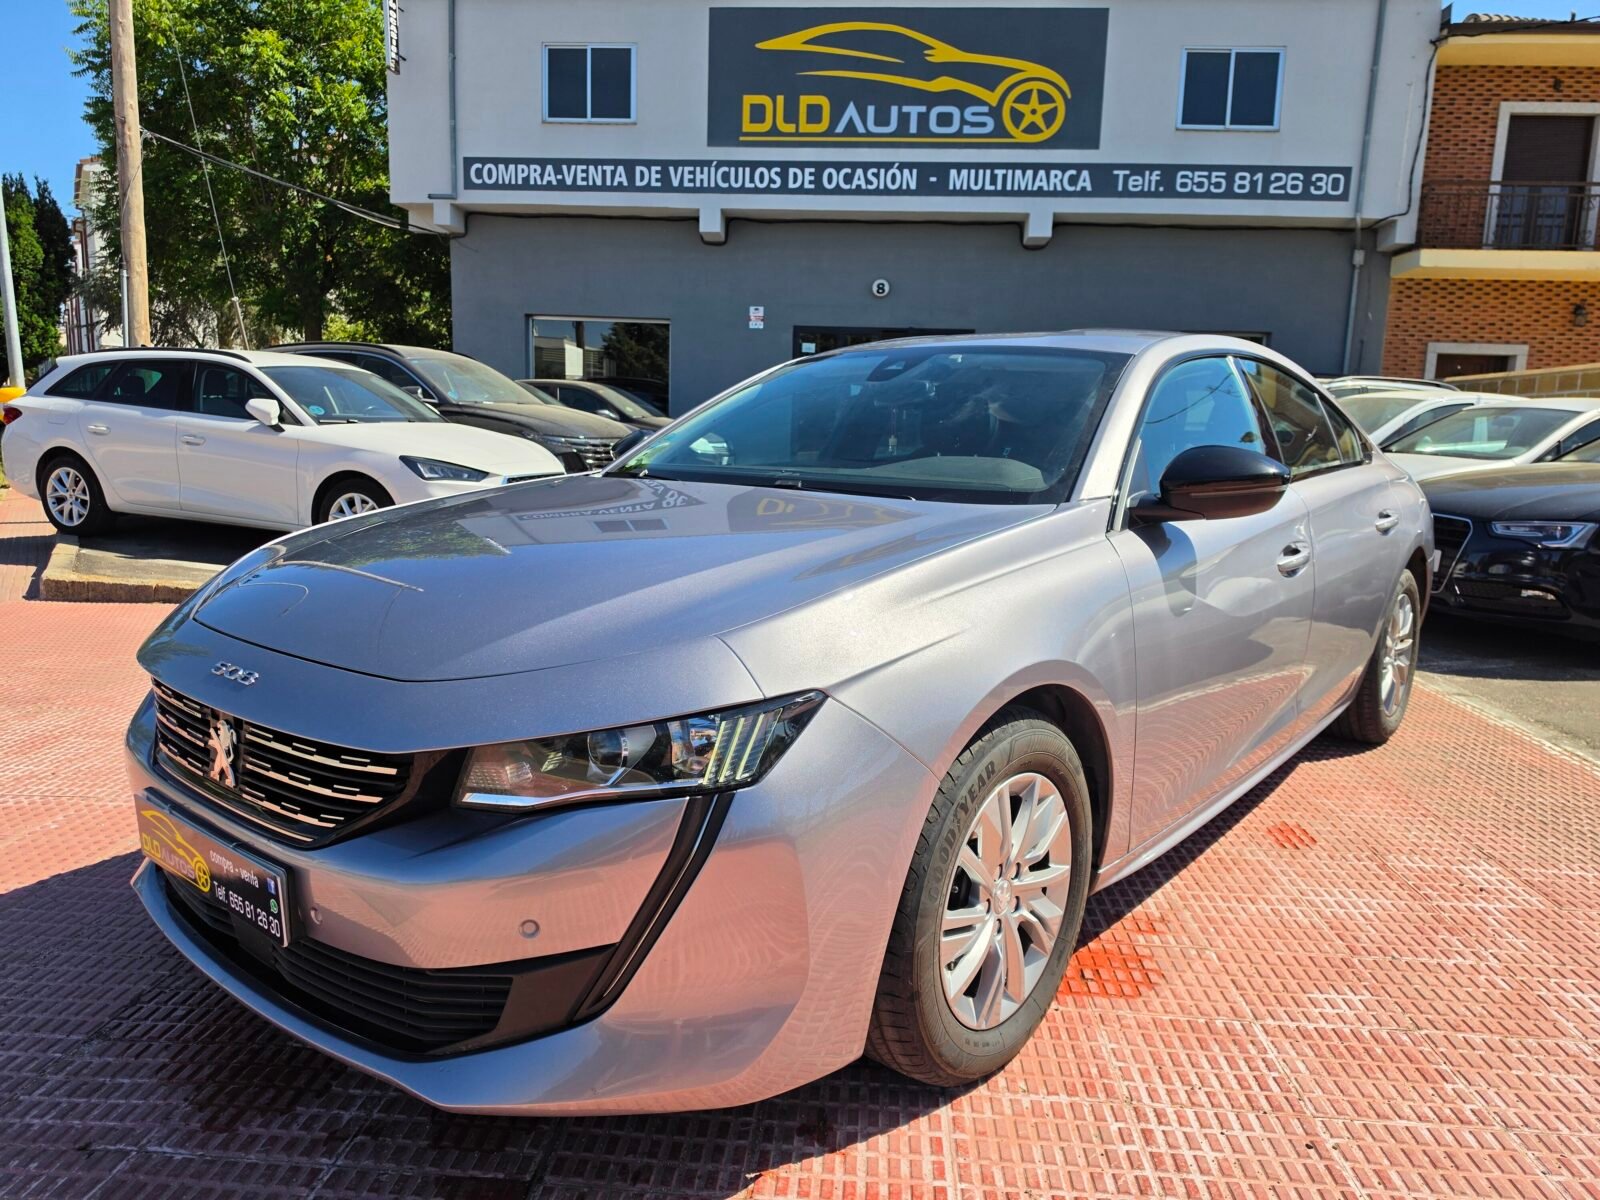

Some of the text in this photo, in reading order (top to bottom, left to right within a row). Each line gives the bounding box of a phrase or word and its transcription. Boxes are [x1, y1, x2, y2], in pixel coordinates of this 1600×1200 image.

[742, 95, 995, 134] DLD AUTOS
[470, 163, 628, 186] COMPRA-VENTA
[635, 165, 662, 187] DE
[669, 161, 781, 189] VEHÍCULOS
[788, 167, 815, 189] DE
[822, 163, 917, 190] OCASIÓN
[948, 168, 1092, 192] MULTIMARCA
[1113, 170, 1164, 192] Telf.
[1175, 171, 1226, 193] 655
[1233, 172, 1264, 194] 81
[1269, 172, 1304, 195] 26
[1310, 173, 1345, 195] 30
[876, 283, 886, 294] 8
[211, 661, 259, 685] 508
[161, 849, 195, 879] AUTOS
[209, 850, 234, 873] compra
[240, 868, 259, 888] venta
[214, 882, 281, 937] Telf. 655 81 26 30
